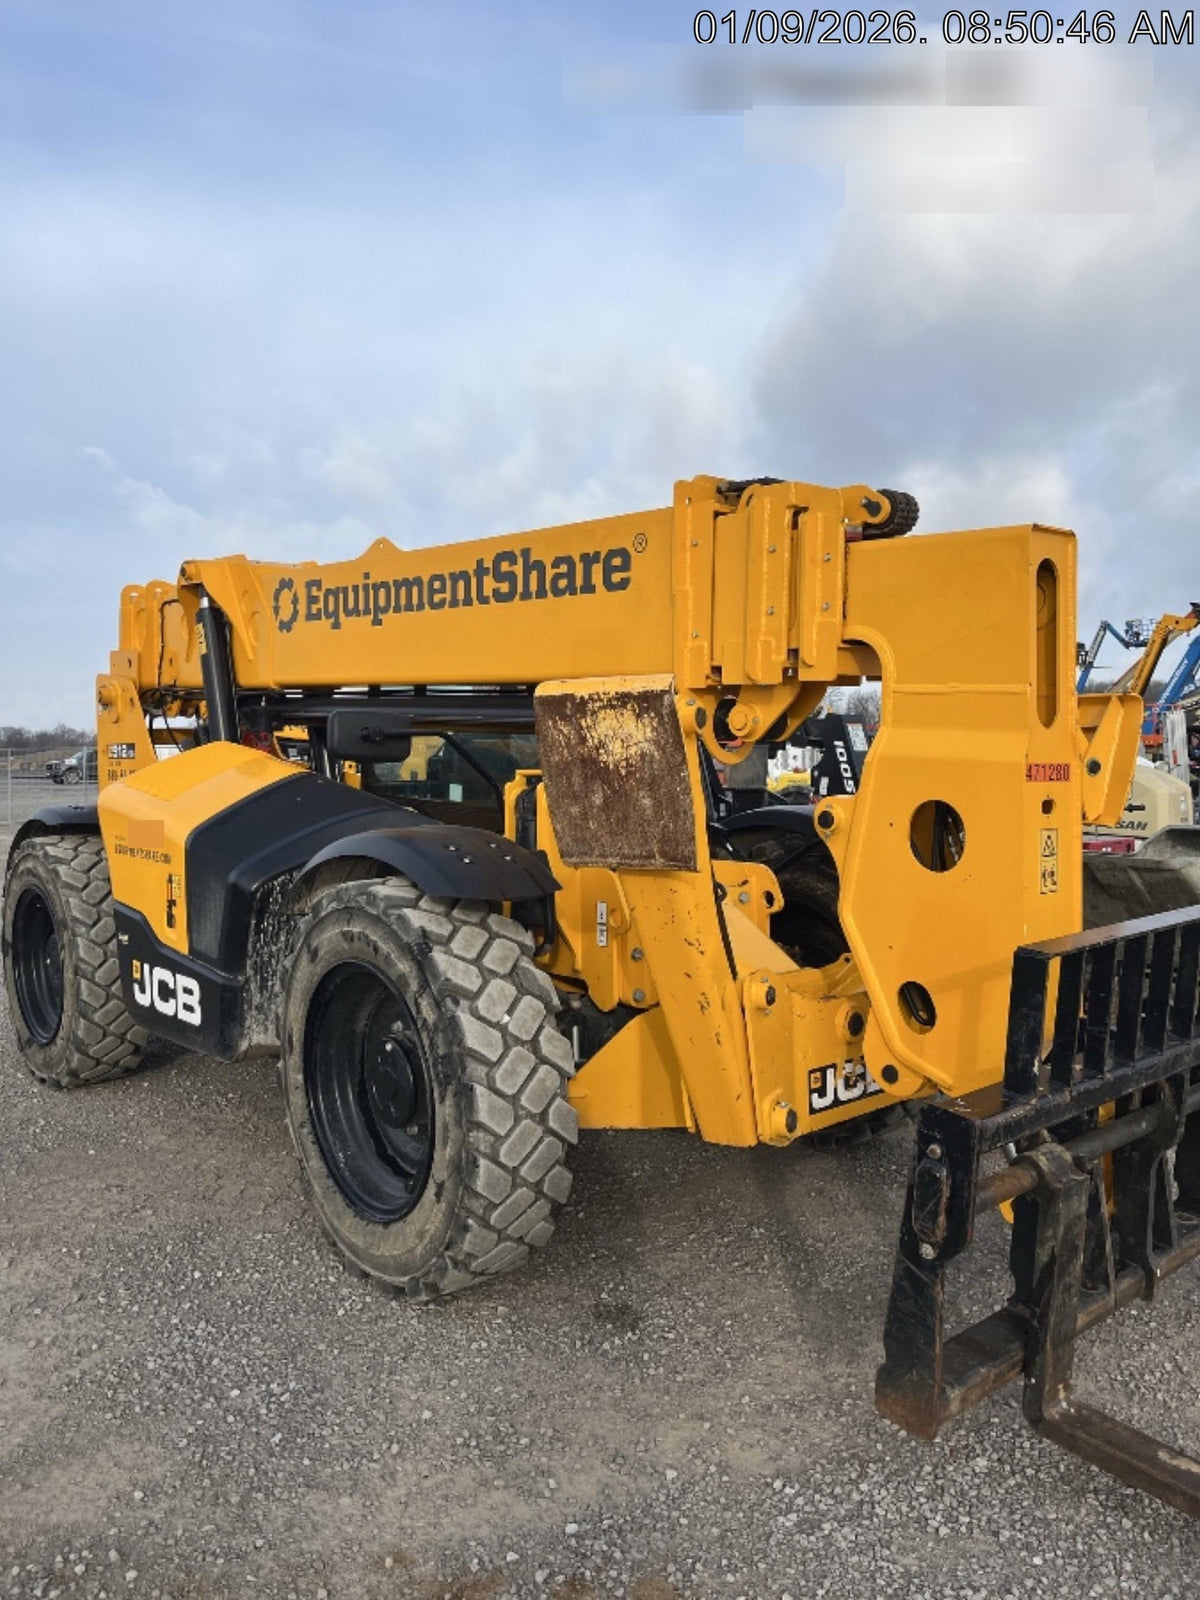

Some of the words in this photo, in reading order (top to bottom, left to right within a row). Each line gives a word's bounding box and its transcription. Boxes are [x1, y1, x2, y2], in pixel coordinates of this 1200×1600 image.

[1026, 764, 1070, 782] 471280
[132, 963, 202, 1027] JCB
[811, 1062, 881, 1110] JC
